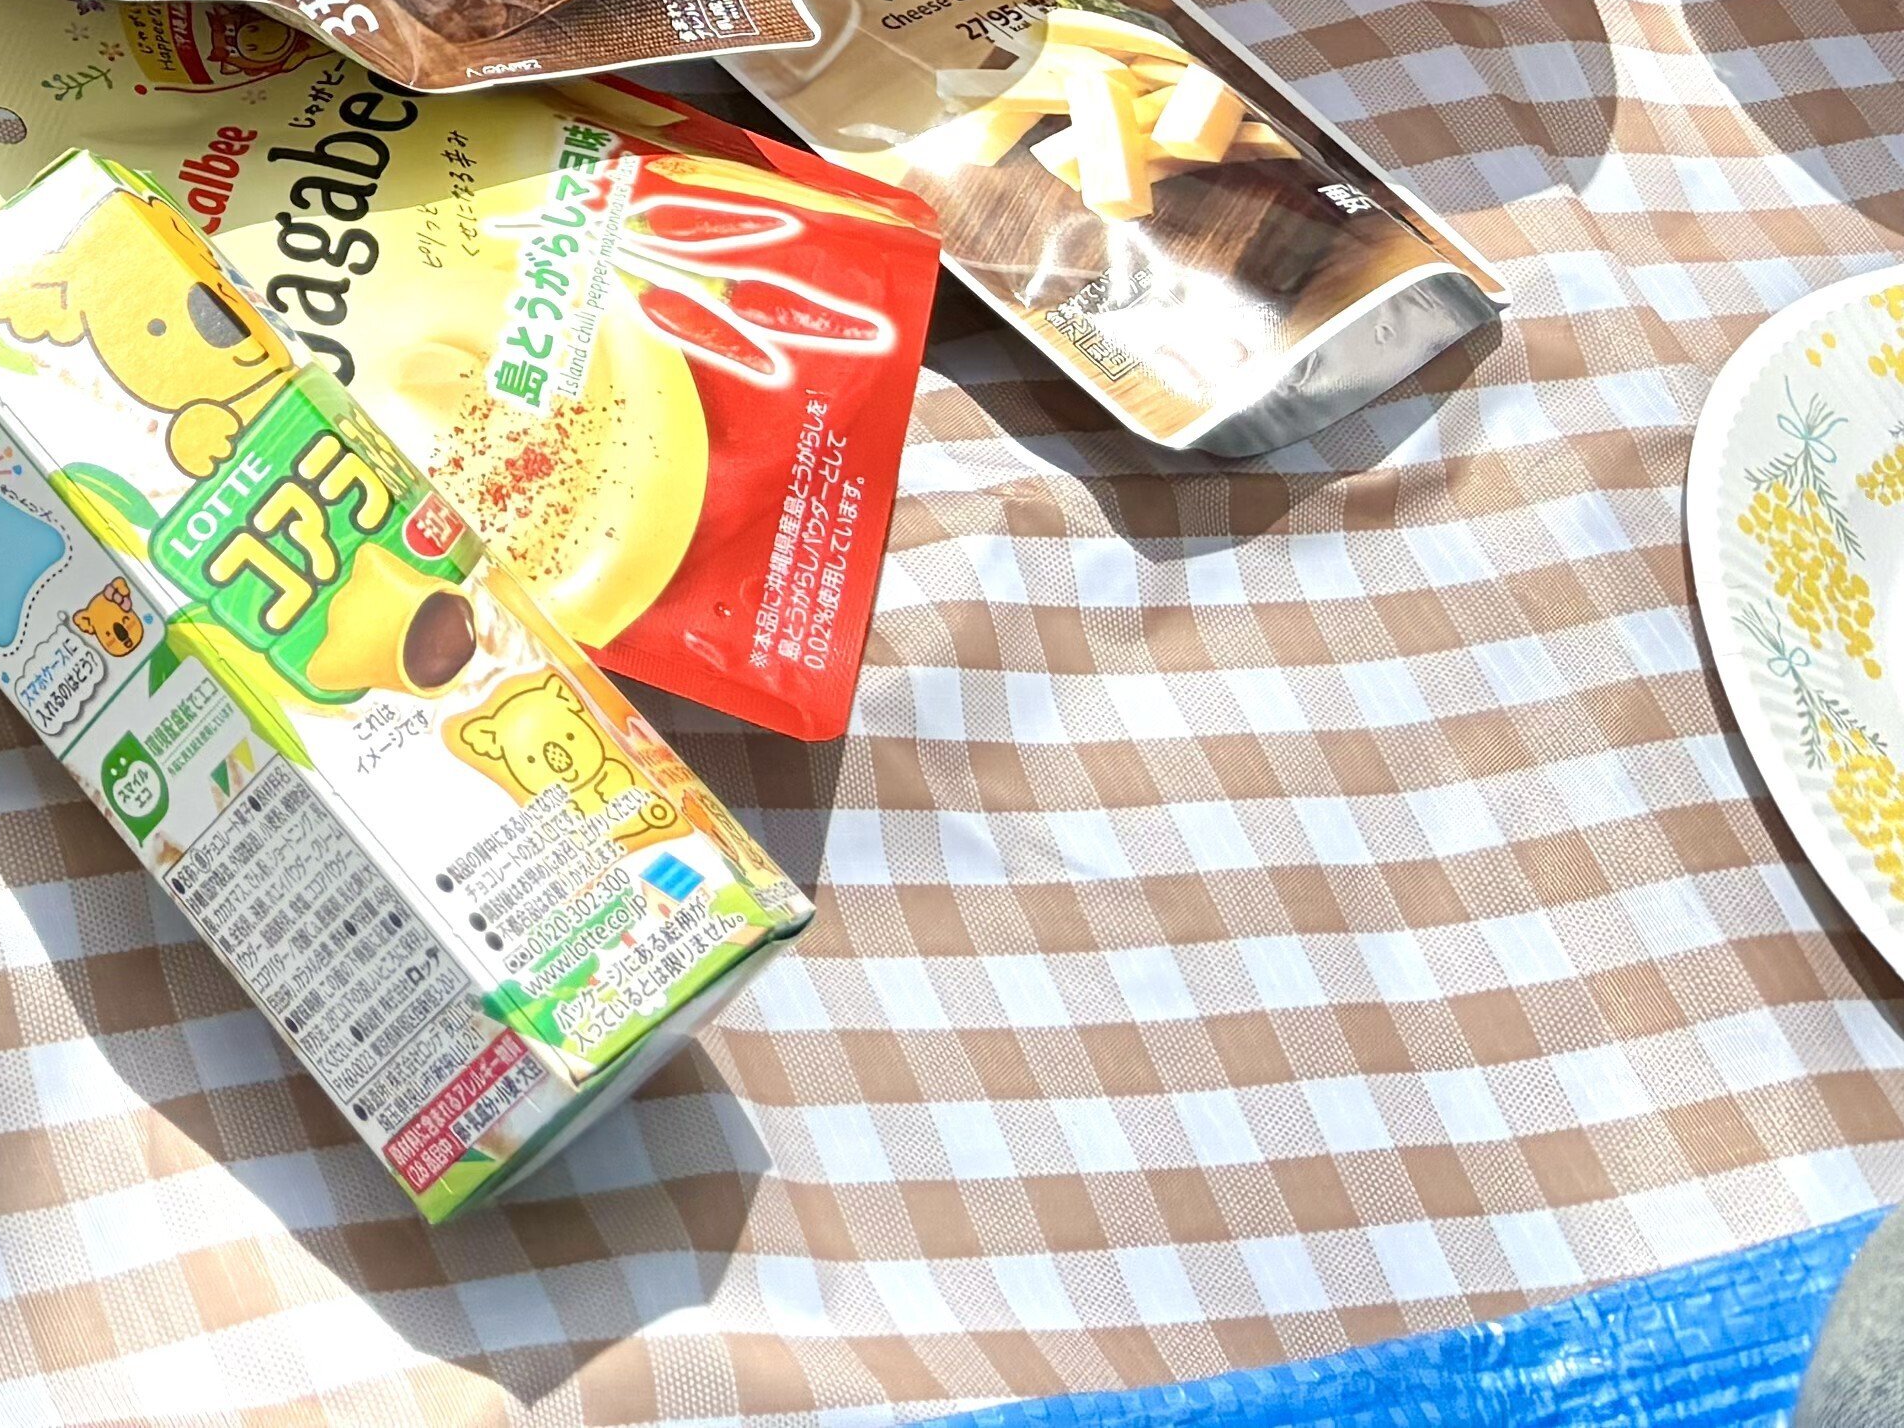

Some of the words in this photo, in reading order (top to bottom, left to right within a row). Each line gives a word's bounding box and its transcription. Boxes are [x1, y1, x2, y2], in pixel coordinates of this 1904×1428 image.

[494, 124, 613, 409] 島とうがらしマヨ味
[557, 344, 588, 397] Island
[169, 450, 273, 562] LOTTE
[202, 428, 396, 636] コアラ
[776, 429, 848, 663] 島とうがらしパウダーとして
[19, 636, 81, 708] スマホケースに
[352, 702, 398, 743] これは
[117, 770, 150, 805] スマイル
[355, 707, 431, 776] イメージです
[134, 787, 154, 809] エコ
[525, 895, 650, 999] www.lotte.co.jp
[554, 897, 707, 1031] パッケージにある絵柄が
[571, 912, 746, 1054] 入っているとは限りません。
